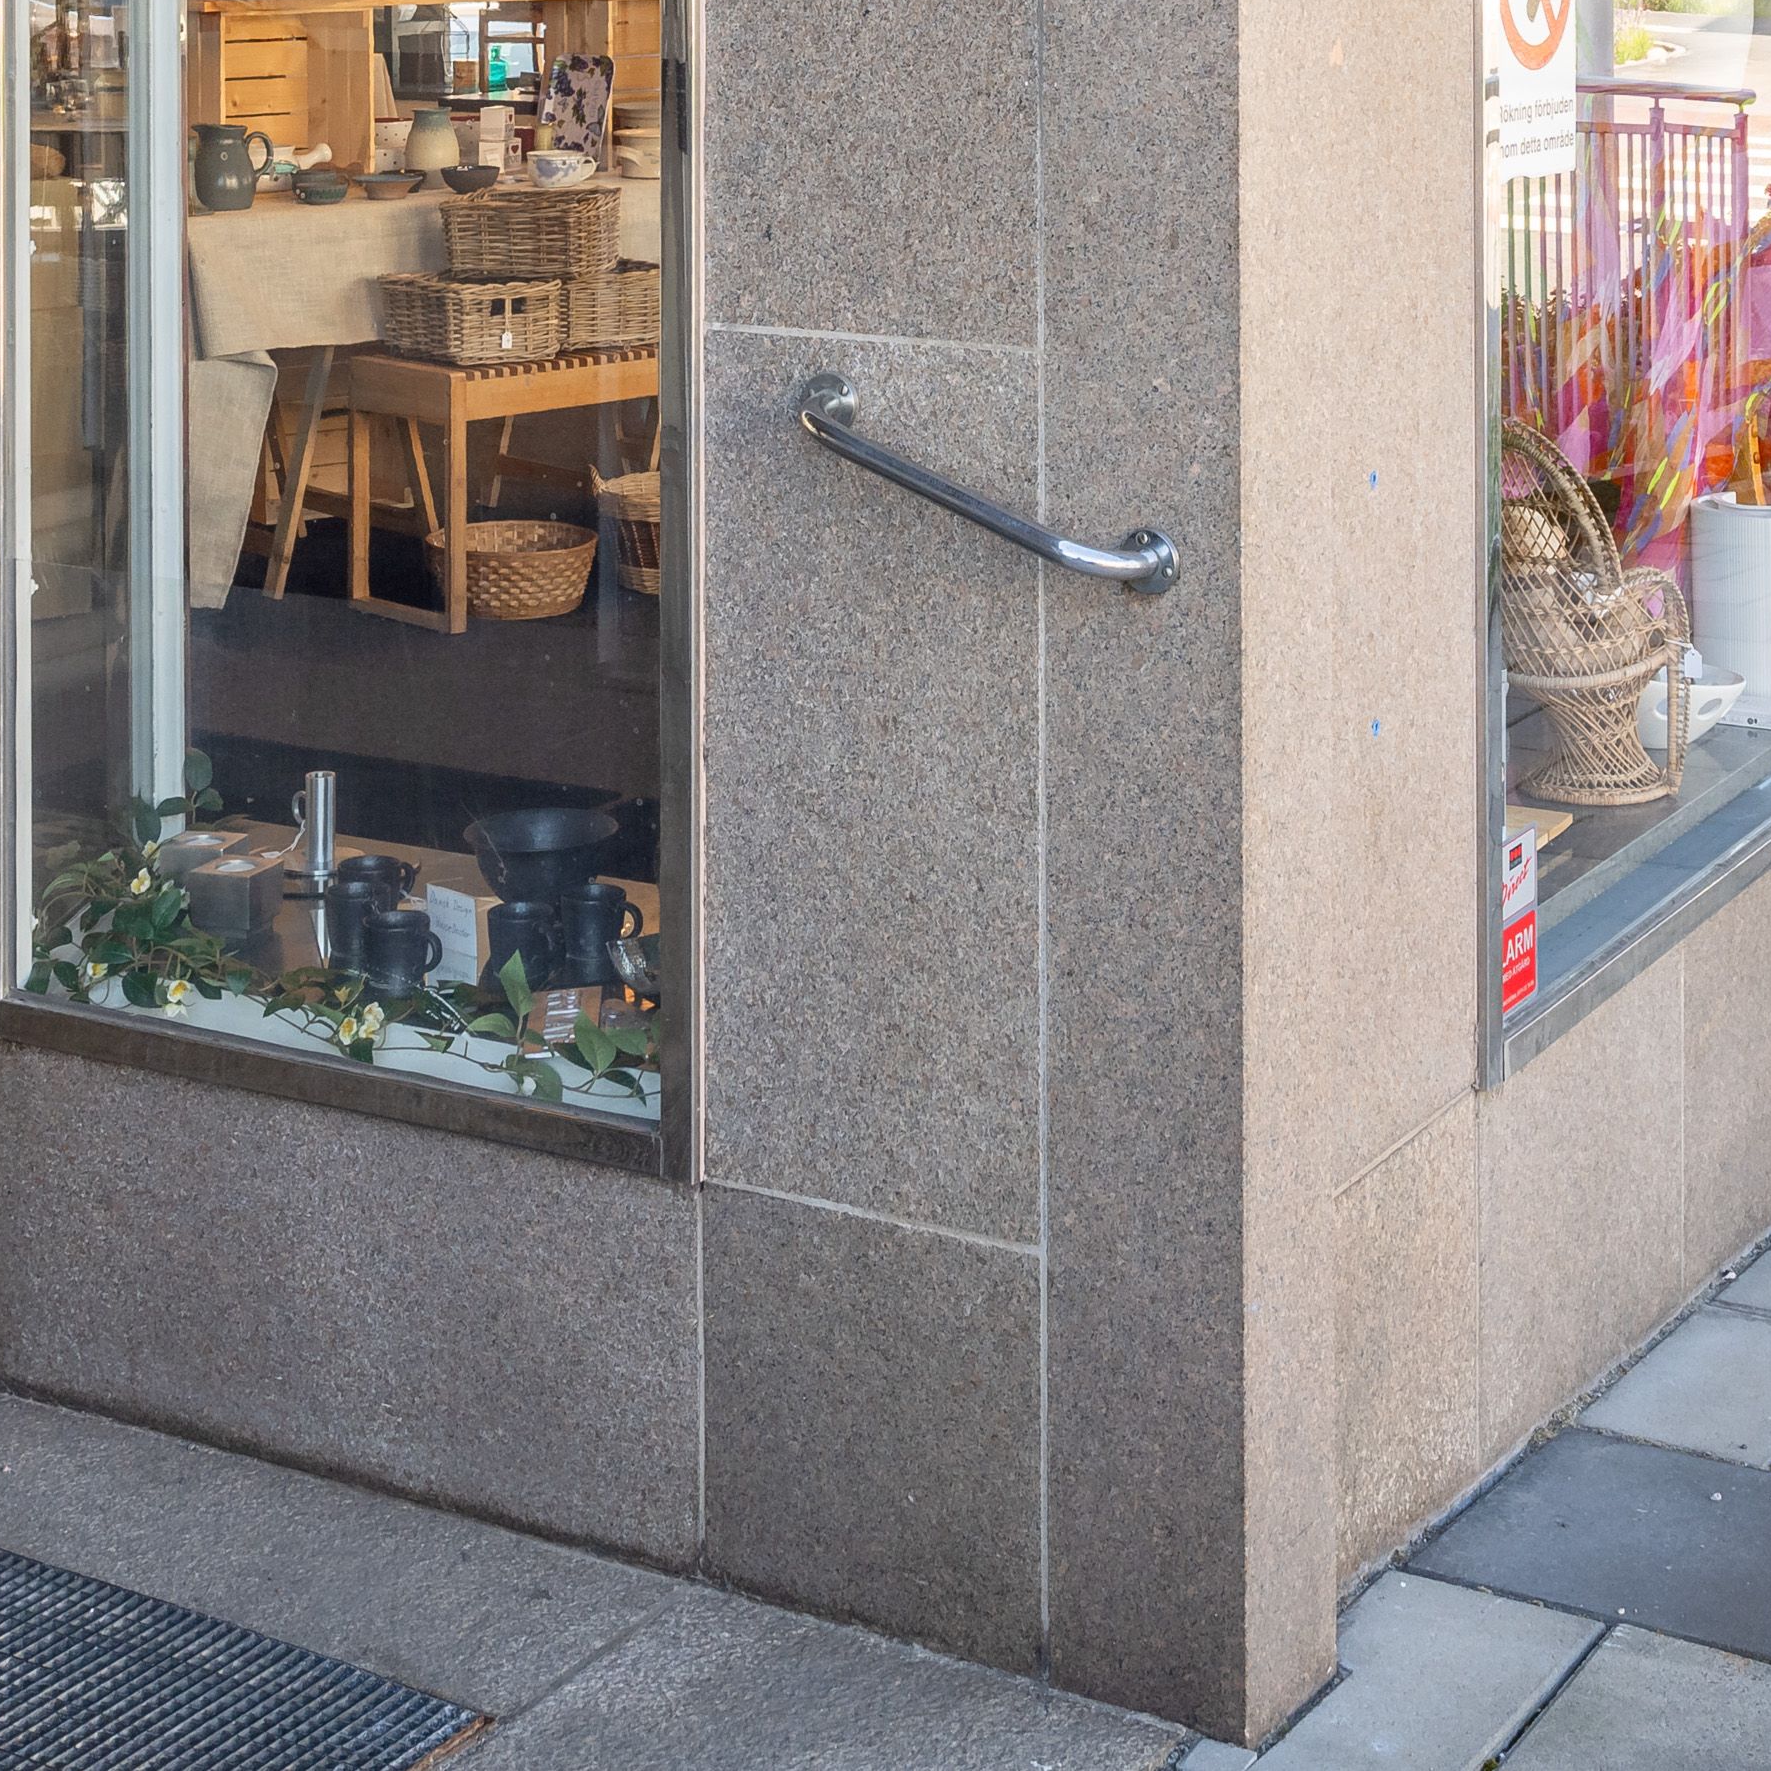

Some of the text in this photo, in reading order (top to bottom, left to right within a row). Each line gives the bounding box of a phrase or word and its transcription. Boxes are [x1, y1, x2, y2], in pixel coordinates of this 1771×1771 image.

[1535, 95, 1574, 120] förbjuden
[1520, 137, 1541, 155] detta
[1544, 129, 1574, 150] område
